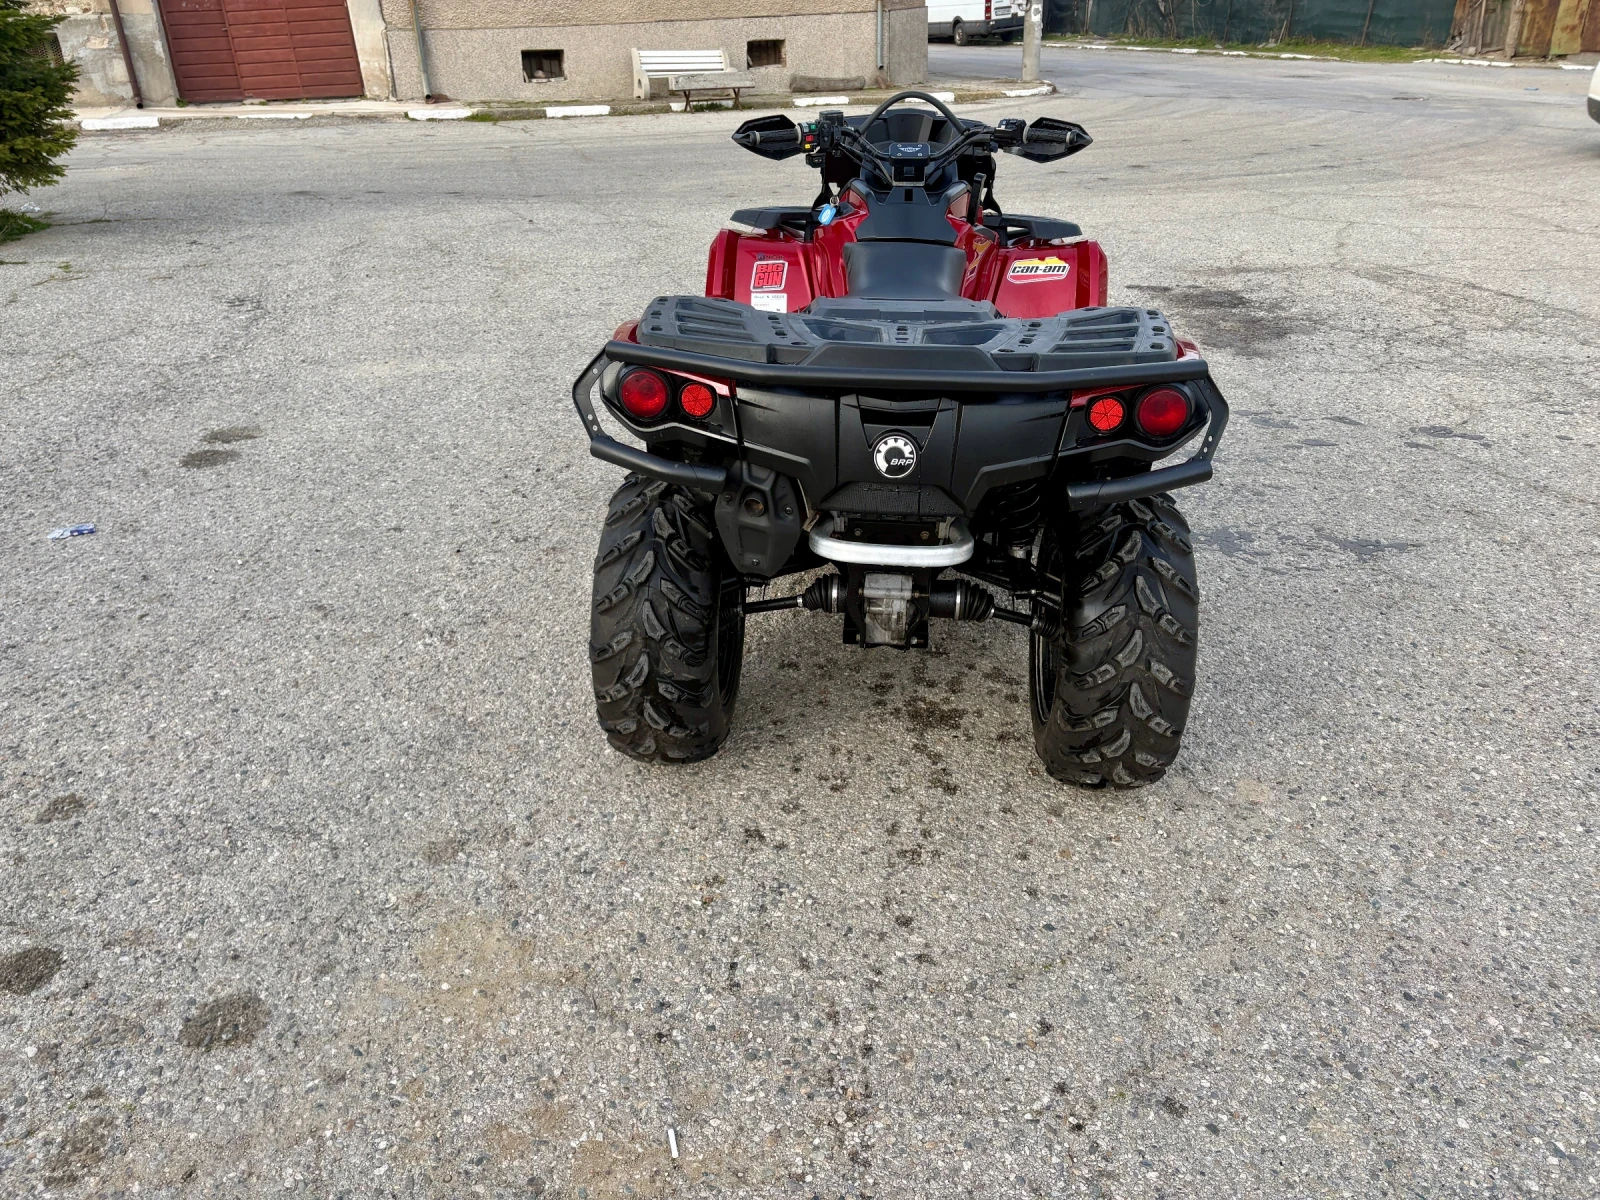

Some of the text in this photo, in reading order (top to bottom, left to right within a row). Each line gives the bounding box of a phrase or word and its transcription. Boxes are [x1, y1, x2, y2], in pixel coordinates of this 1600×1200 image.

[757, 263, 783, 272] BIG
[1011, 265, 1067, 274] can-am
[755, 272, 782, 287] GUN
[890, 458, 913, 466] BRP
